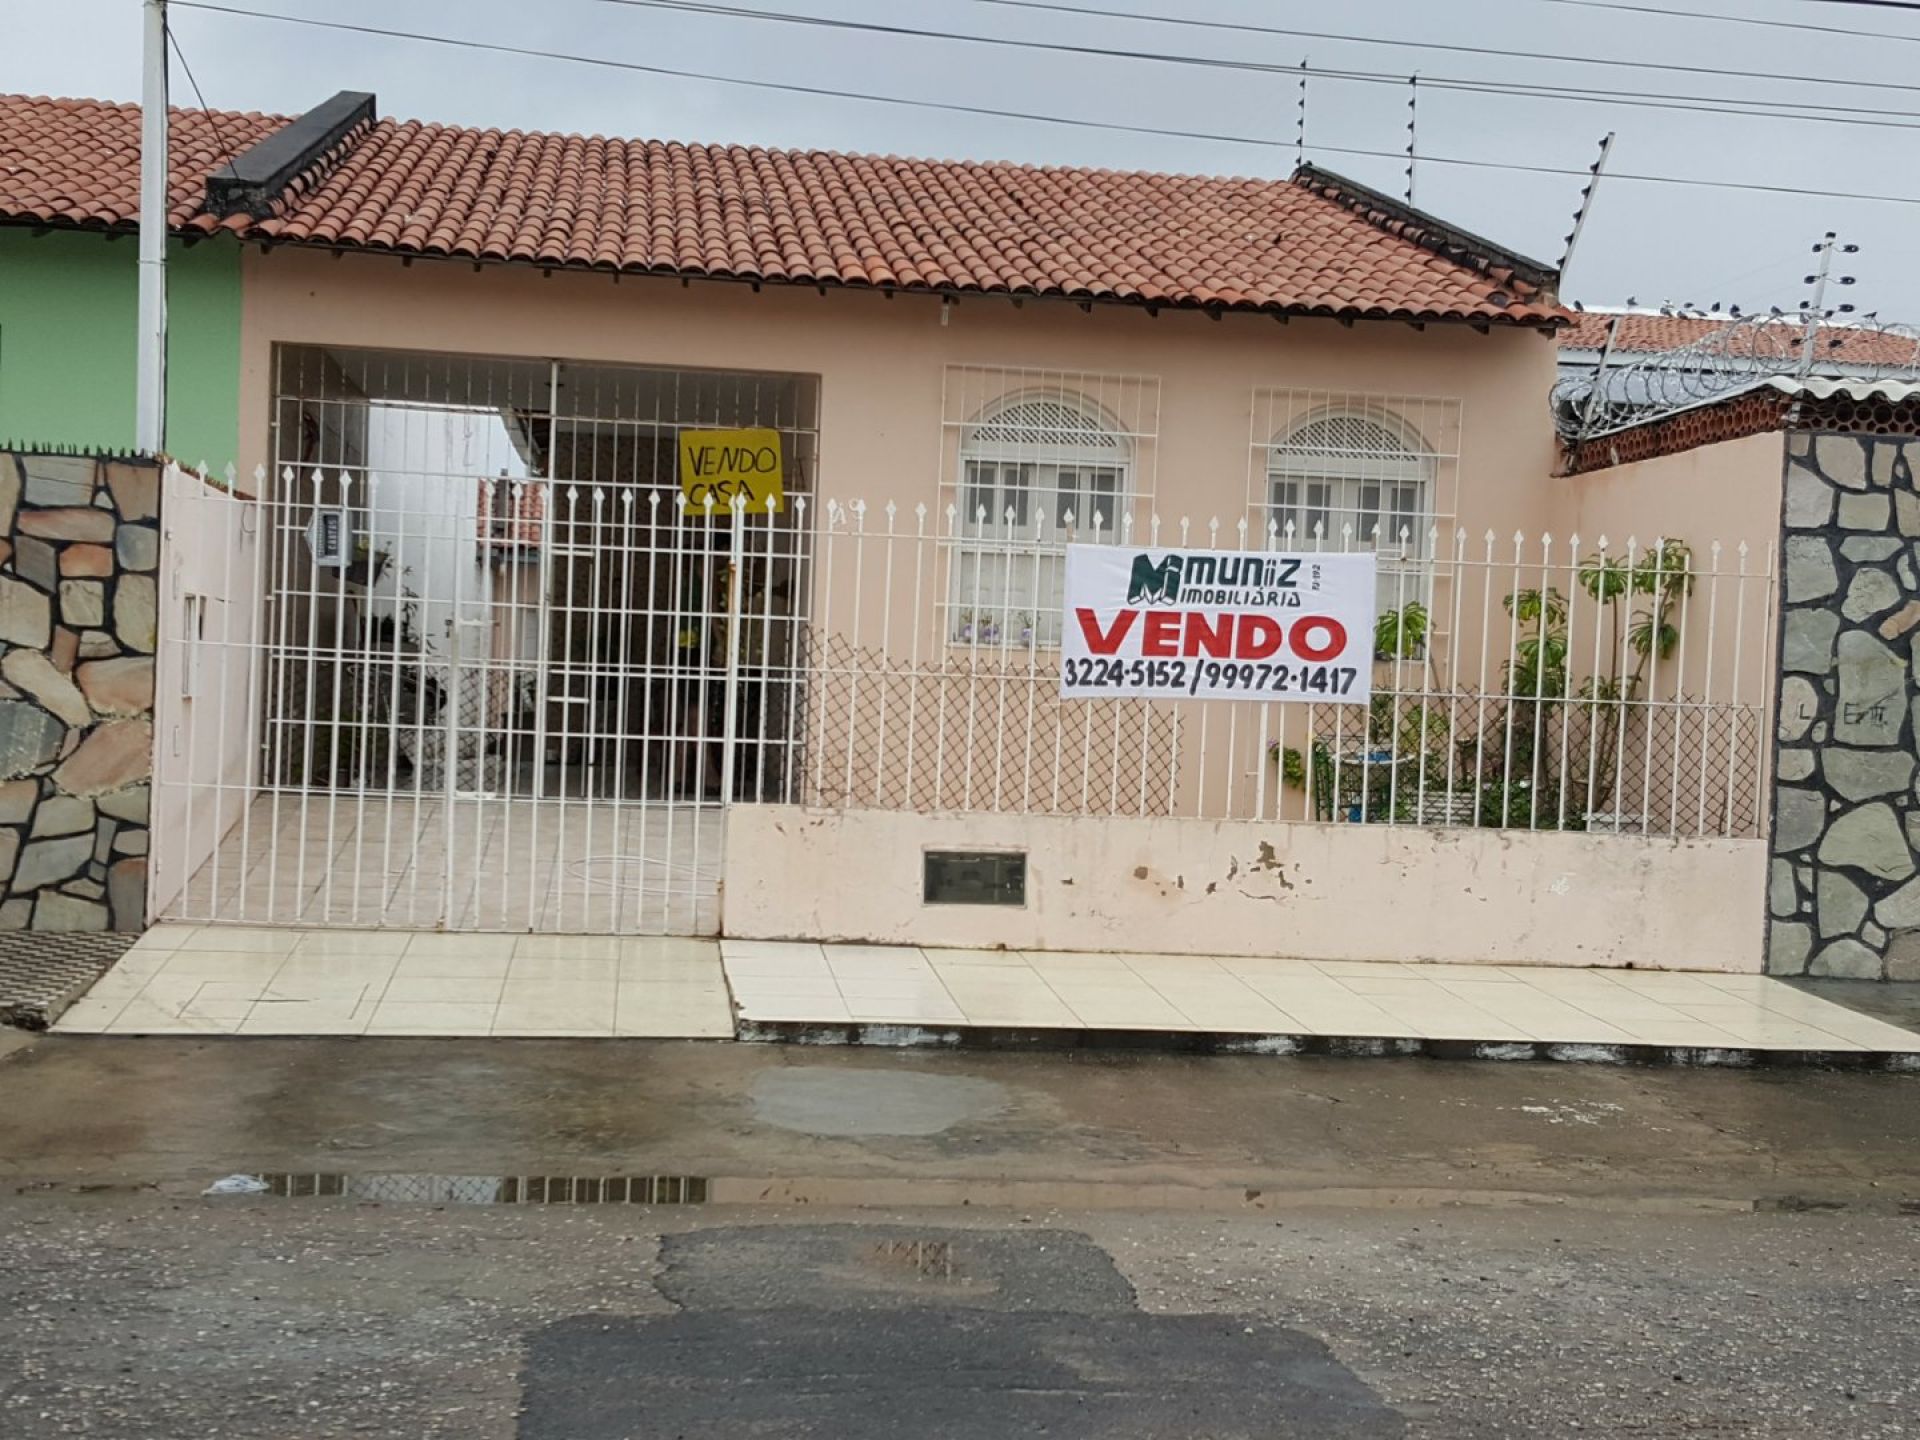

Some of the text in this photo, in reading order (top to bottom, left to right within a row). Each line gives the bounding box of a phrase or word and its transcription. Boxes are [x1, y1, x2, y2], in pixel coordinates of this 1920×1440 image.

[688, 446, 776, 476] VENDO
[690, 480, 755, 506] CASA
[1180, 587, 1301, 607] IMOBILIÁRIA
[1075, 608, 1347, 662] VENDO
